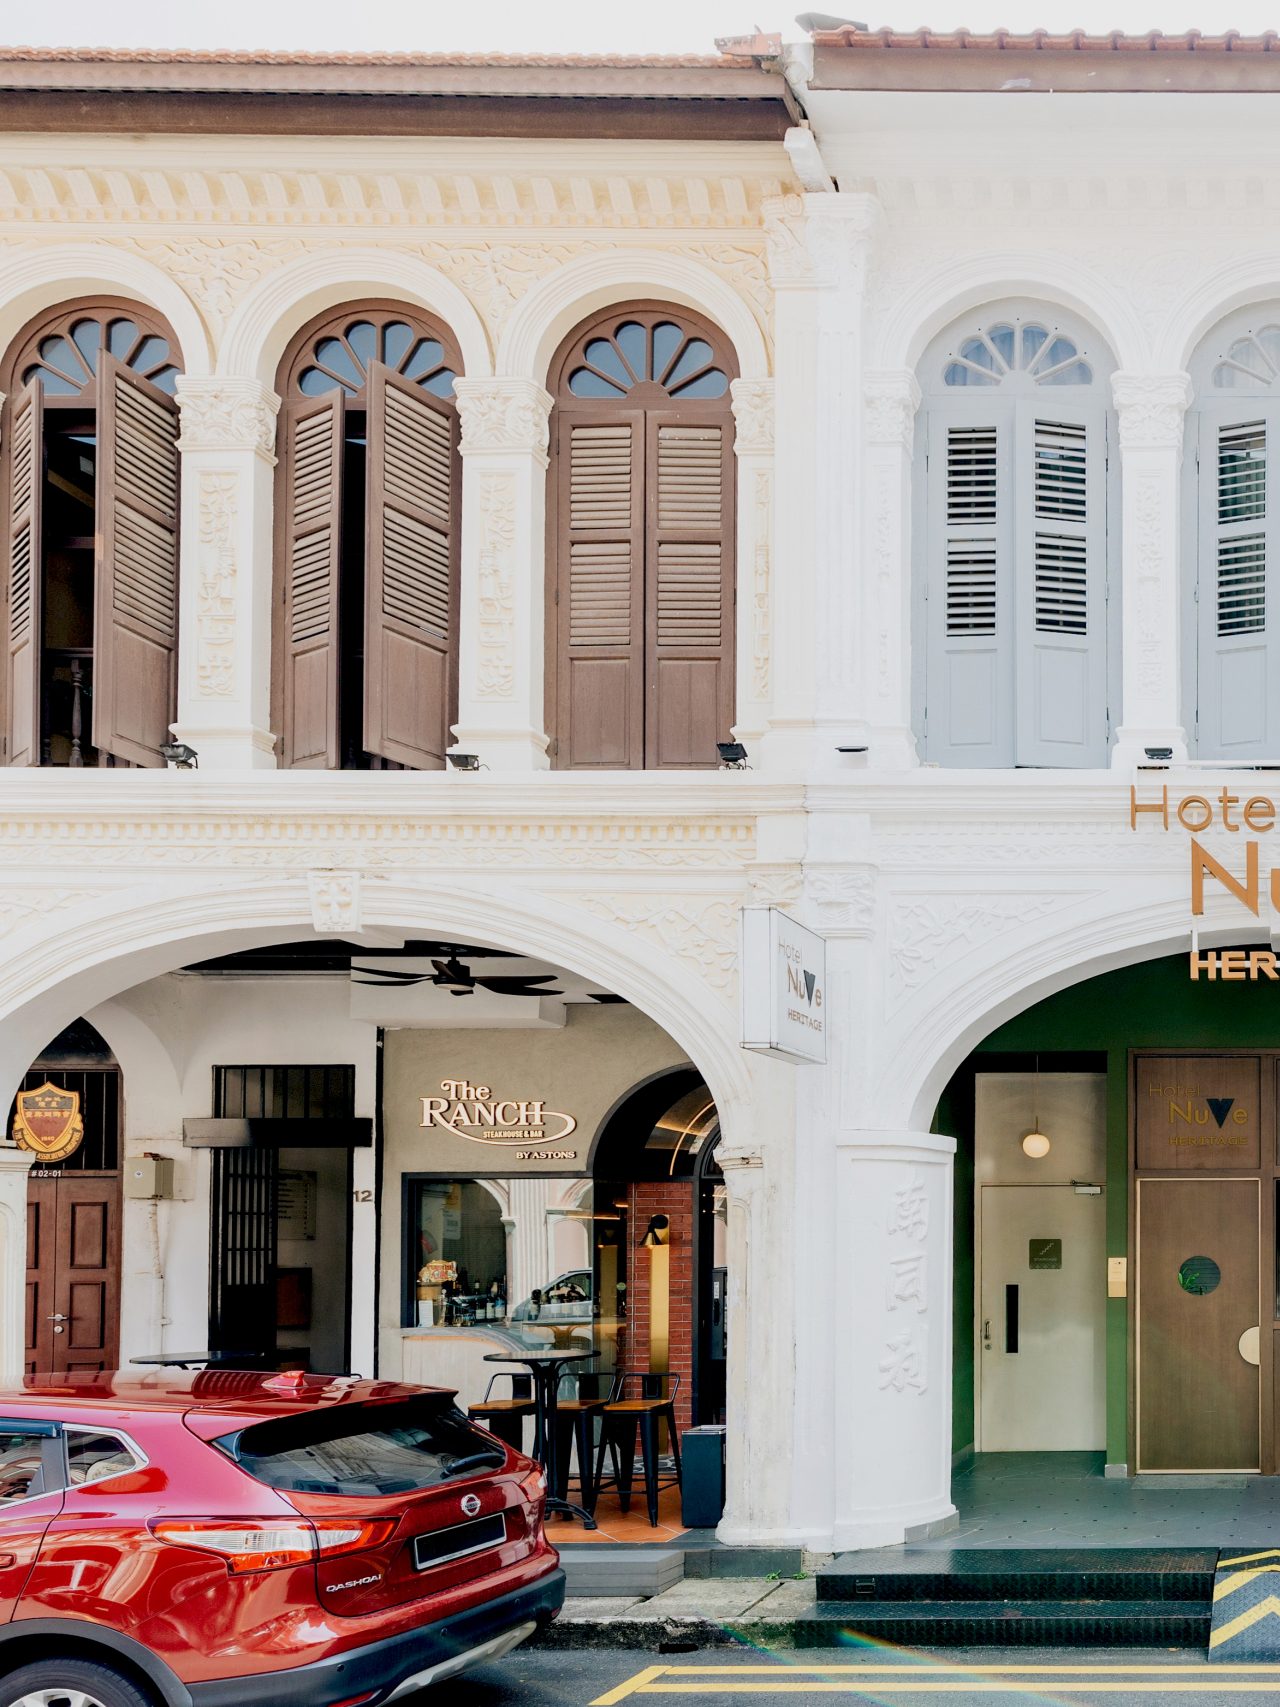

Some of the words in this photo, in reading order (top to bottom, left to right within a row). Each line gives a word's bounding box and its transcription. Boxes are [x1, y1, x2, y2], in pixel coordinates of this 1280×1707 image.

[778, 936, 802, 963] Hotel
[788, 1008, 823, 1032] HERITAGE
[441, 1080, 492, 1100] The
[1149, 1082, 1200, 1097] Hotel
[419, 1097, 546, 1127] RANCH
[482, 1130, 523, 1138] STEAKHOUSE
[524, 1130, 530, 1138] &
[530, 1130, 544, 1138] BAR
[1168, 1136, 1249, 1146] HERITAGE
[516, 1151, 530, 1160] BY
[532, 1151, 577, 1160] ASTONS
[353, 1190, 373, 1203] 12
[325, 1573, 382, 1593] QASHQAI
